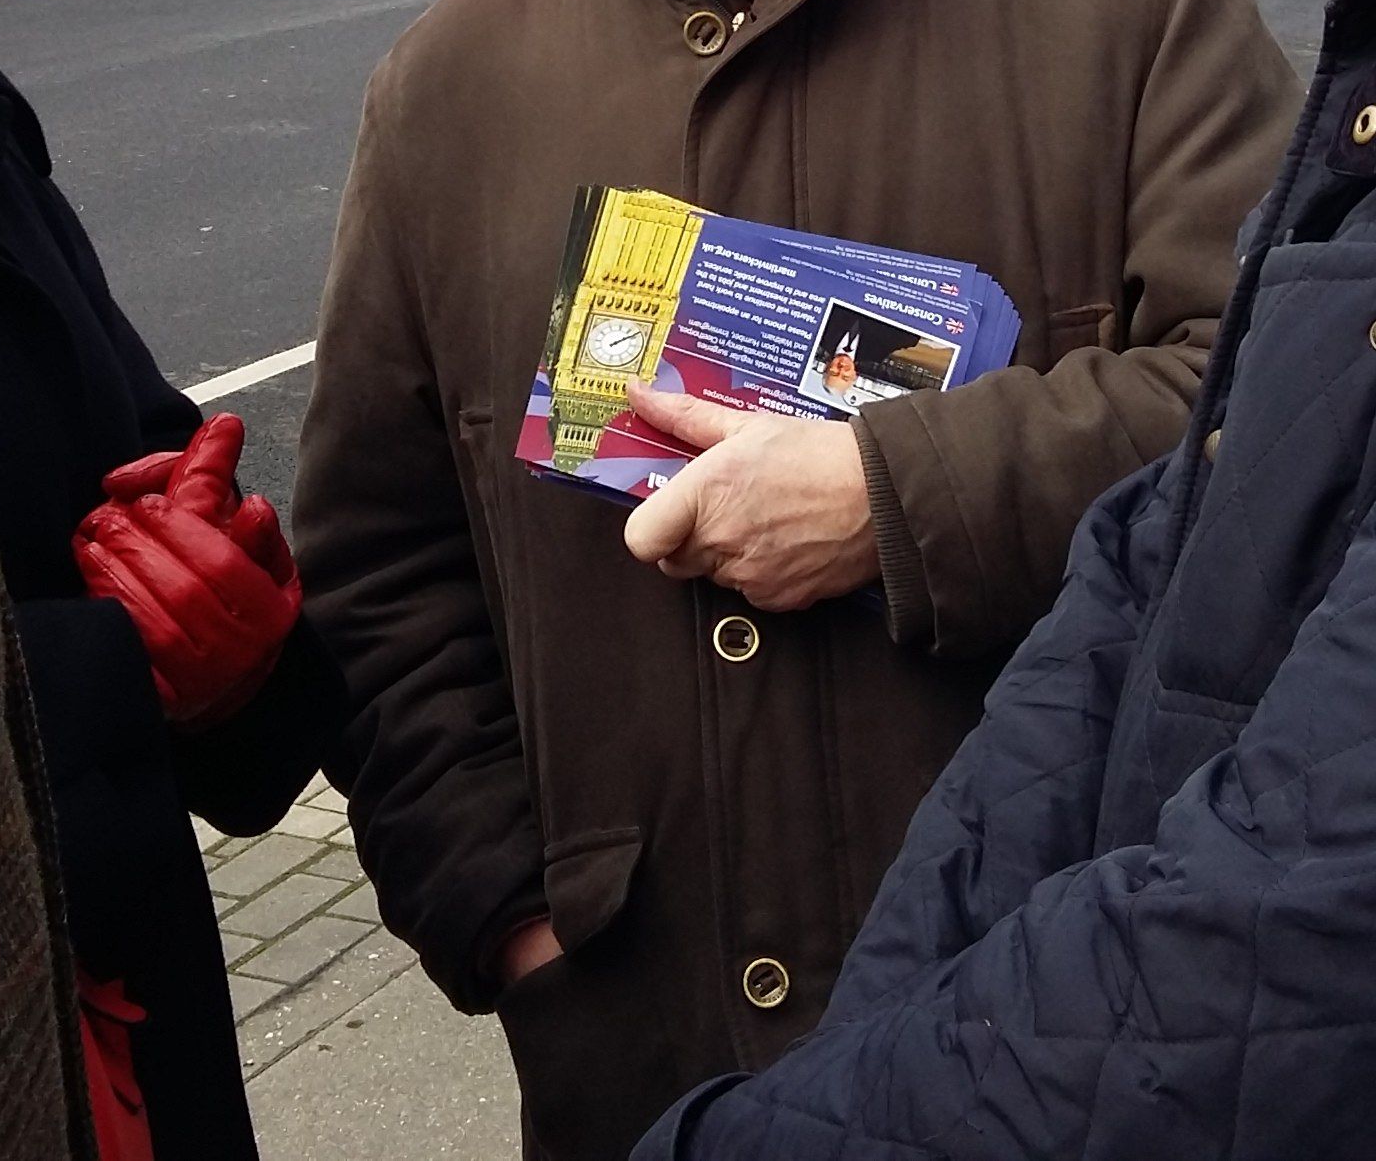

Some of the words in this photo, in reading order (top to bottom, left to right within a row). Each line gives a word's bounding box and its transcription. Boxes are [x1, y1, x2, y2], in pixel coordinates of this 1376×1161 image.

[702, 242, 796, 277] martinvickers.org.uk
[695, 269, 708, 278] the
[708, 273, 717, 281] to
[733, 270, 756, 282] public
[696, 280, 715, 292] hard
[717, 276, 735, 287] jobs
[733, 281, 749, 290] and
[755, 277, 784, 291] improve
[715, 286, 734, 296] work
[734, 292, 743, 300] to
[748, 286, 788, 304] investment
[784, 286, 793, 294] to
[792, 288, 808, 298] and
[743, 295, 776, 309] continue
[788, 298, 813, 310] attract
[808, 293, 826, 303] area
[692, 295, 739, 315] appointment.
[775, 305, 789, 314] will
[813, 305, 822, 314] to
[864, 293, 943, 325] Conservatives
[740, 311, 750, 319] an
[750, 314, 762, 324] for
[688, 319, 729, 337] Immingham
[763, 318, 787, 330] phone
[787, 325, 812, 340] Please
[718, 338, 726, 346] in
[731, 331, 760, 347] Humber,
[760, 331, 792, 347] Waltham.
[696, 341, 728, 356] surgeries
[725, 339, 767, 358] constituency
[760, 341, 779, 353] Upon
[793, 341, 808, 351] and
[728, 352, 753, 364] regular
[766, 353, 778, 363] the
[780, 347, 804, 361] Barton
[754, 359, 774, 372] holds
[779, 357, 801, 369] across
[774, 366, 798, 379] Martin
[702, 388, 744, 408] Cleethorpes
